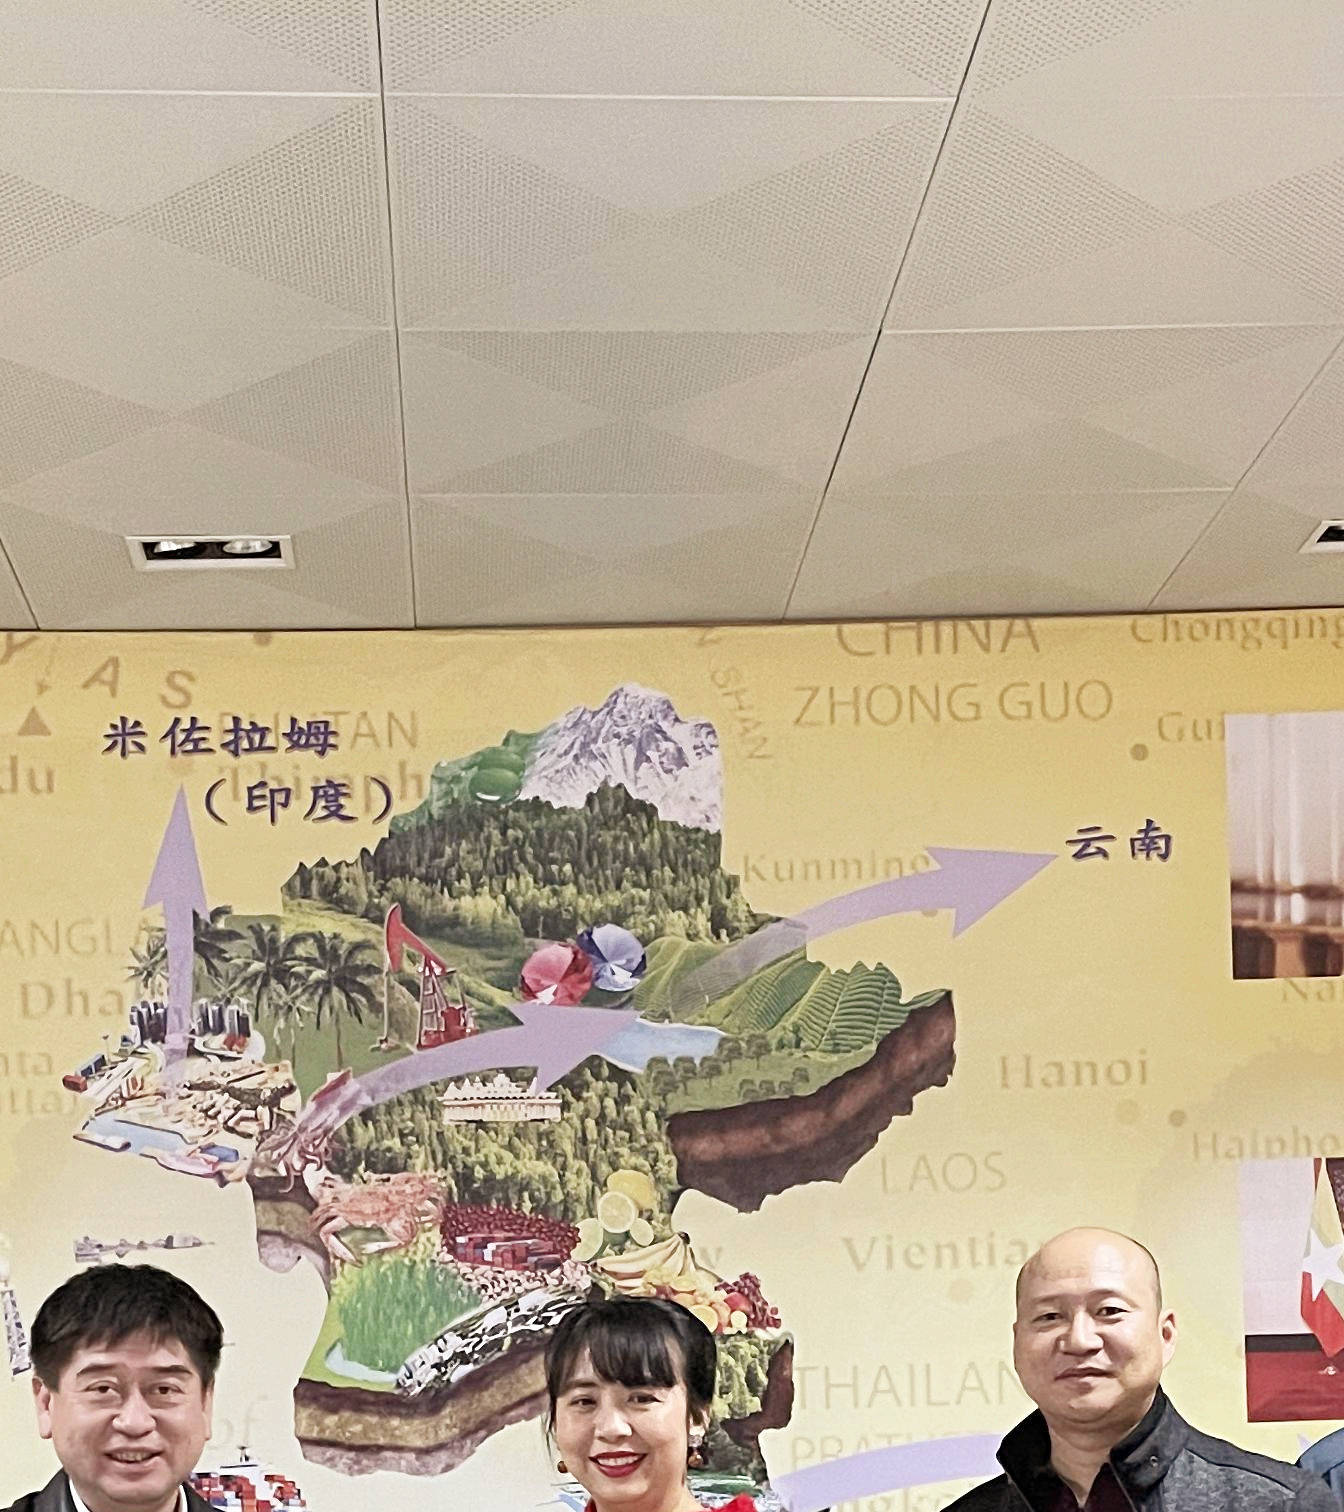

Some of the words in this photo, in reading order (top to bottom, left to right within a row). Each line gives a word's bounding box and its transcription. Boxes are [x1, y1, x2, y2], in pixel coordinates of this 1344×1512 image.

[837, 620, 1040, 657] CHINA
[793, 682, 983, 728] ZHONG
[997, 680, 1113, 726] GUO
[101, 714, 340, 760] 米佐拉姆
[1064, 818, 1174, 863] 云南
[999, 1049, 1151, 1090] Hanoi
[881, 1151, 1008, 1193] LAOS
